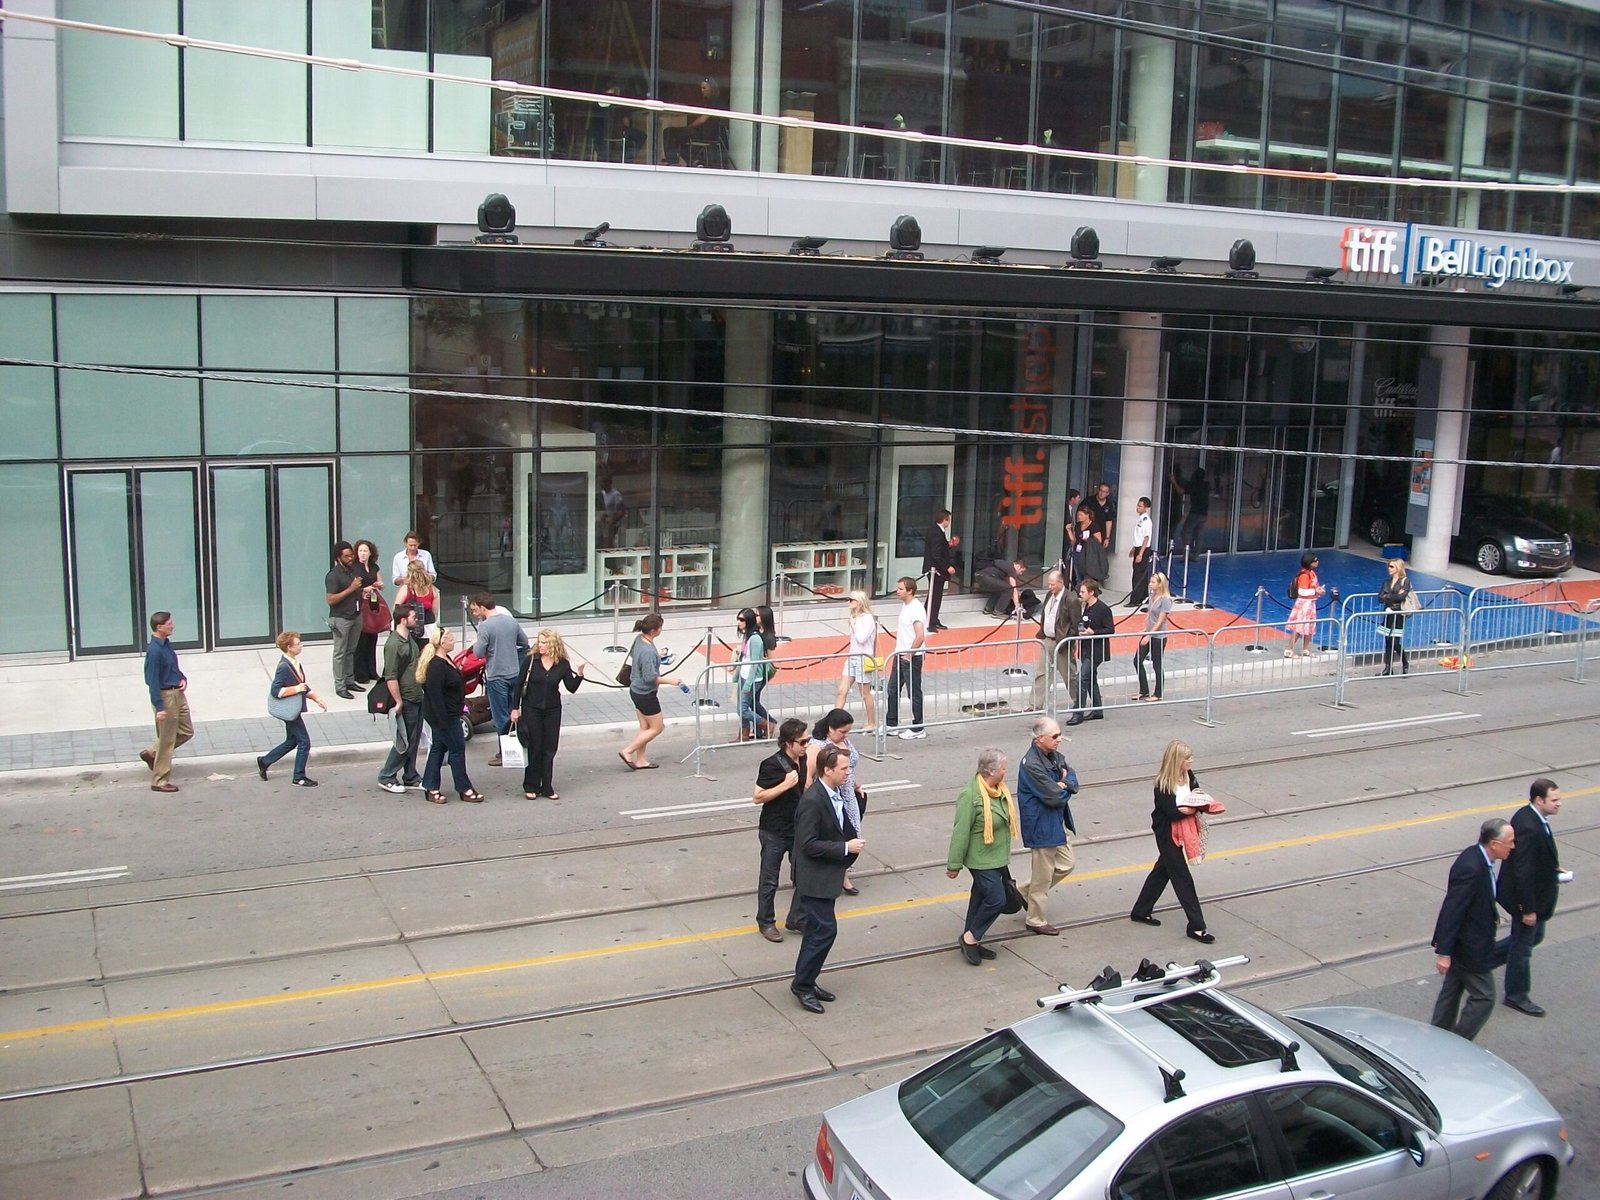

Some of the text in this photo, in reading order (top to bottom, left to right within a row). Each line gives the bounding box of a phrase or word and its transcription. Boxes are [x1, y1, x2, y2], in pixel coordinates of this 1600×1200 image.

[1341, 226, 1400, 275] tiff.
[1418, 236, 1575, 288] Bell Lightbox
